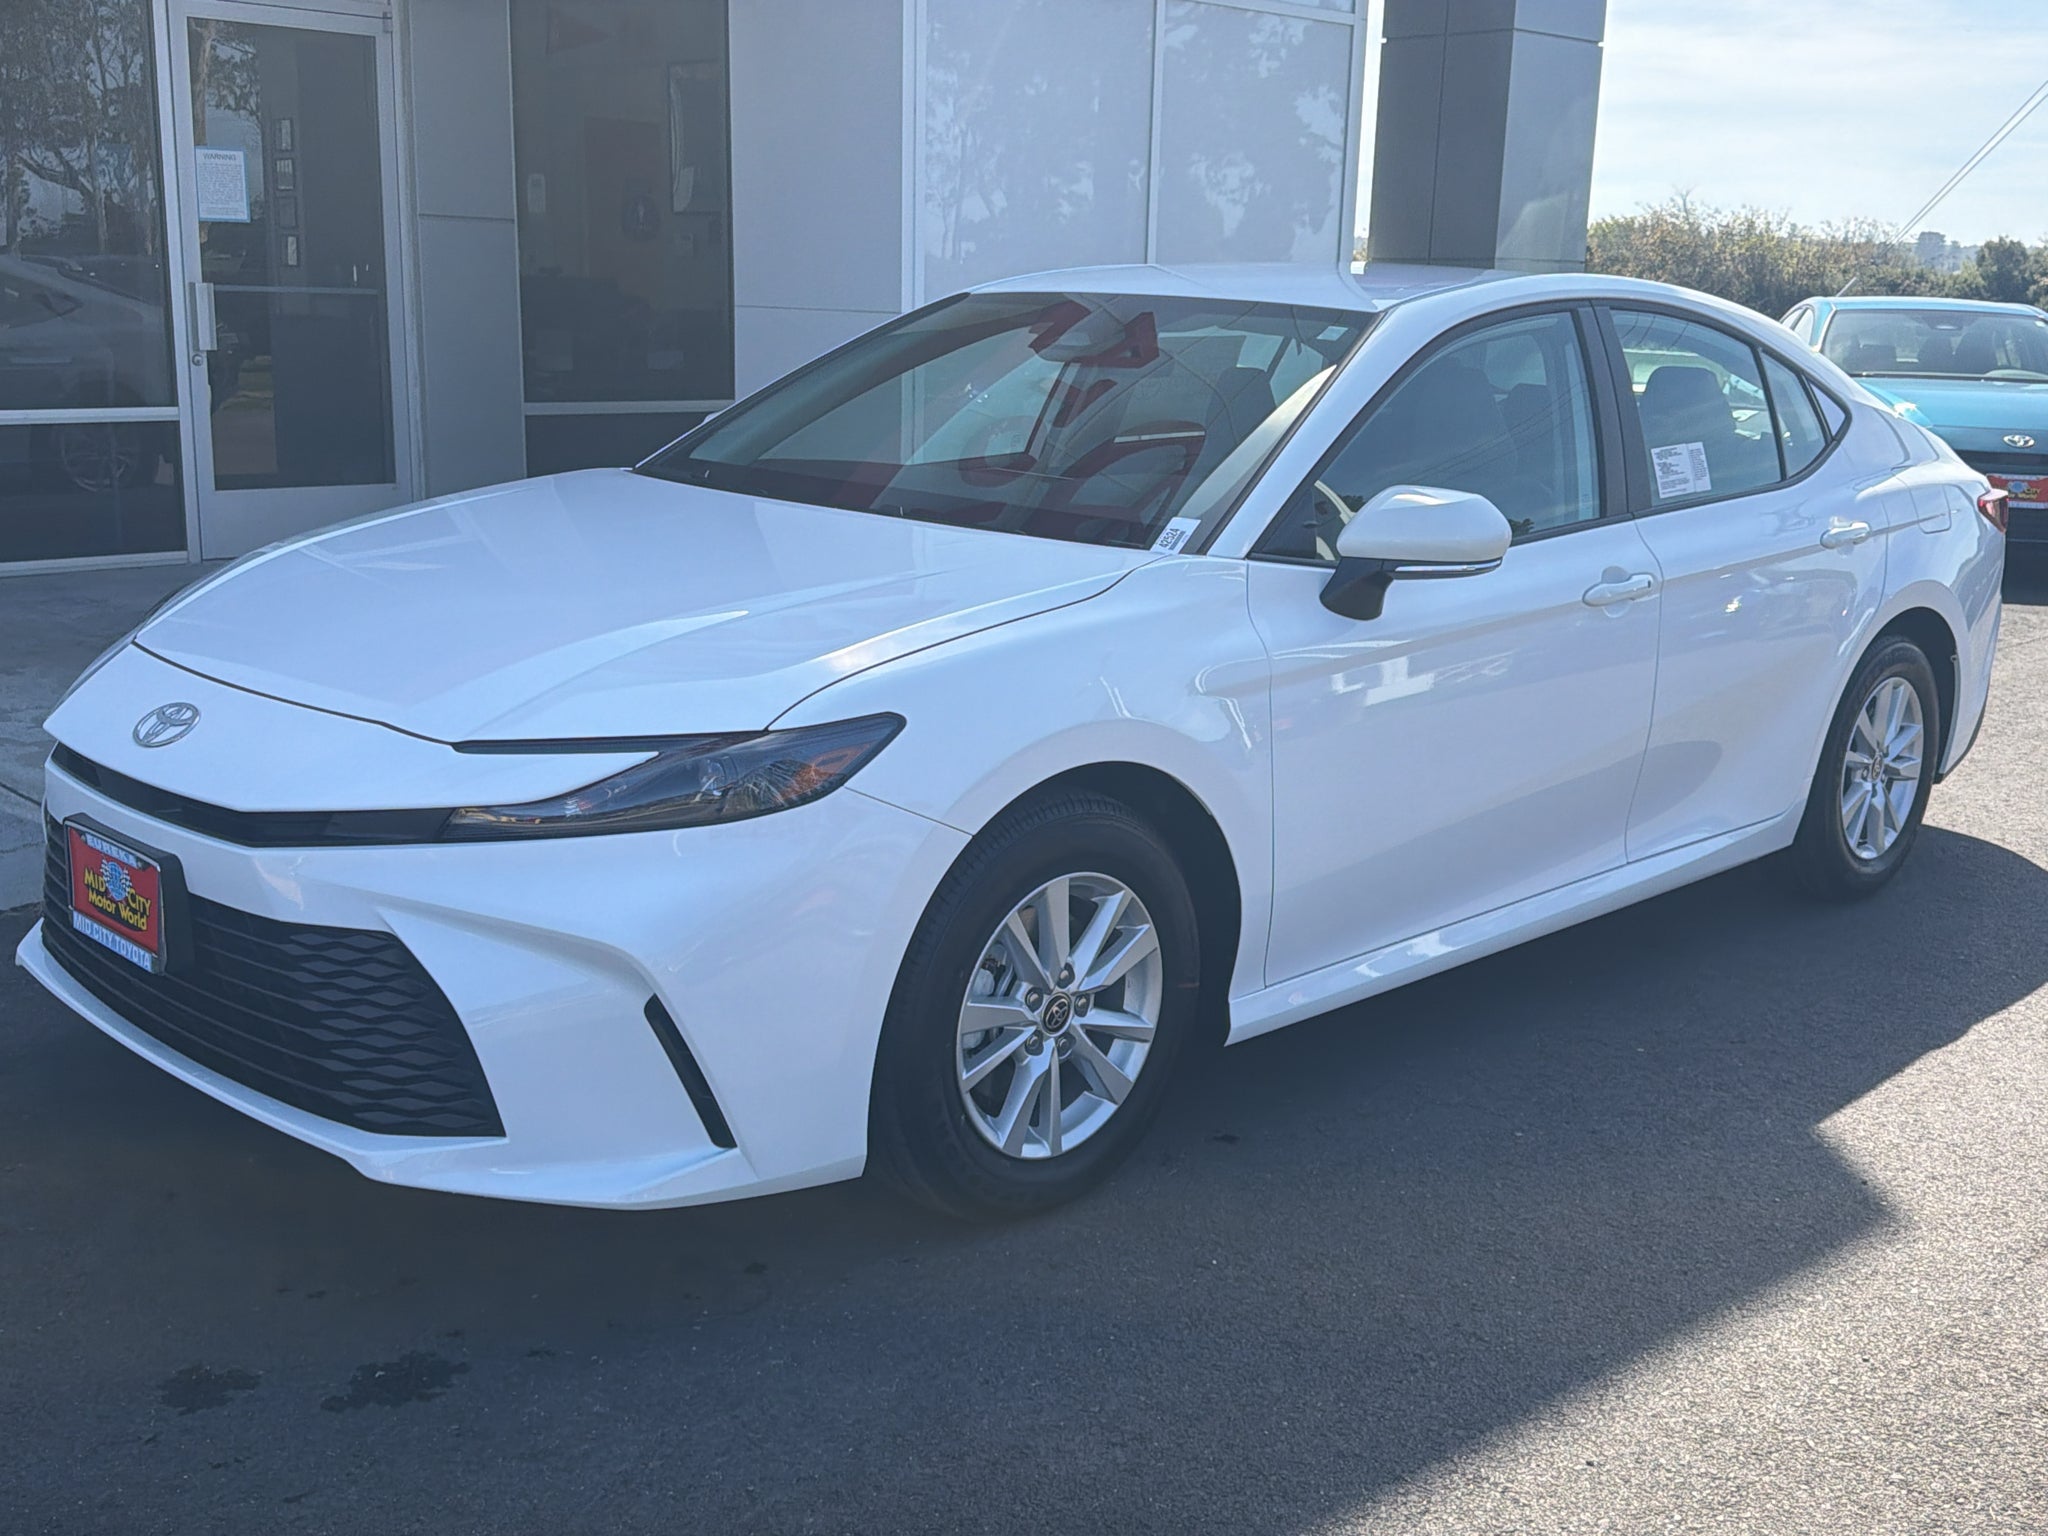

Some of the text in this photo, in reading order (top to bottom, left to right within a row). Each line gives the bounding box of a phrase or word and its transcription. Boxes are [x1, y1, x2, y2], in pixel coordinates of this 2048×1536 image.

[203, 153, 236, 161] WARNING
[84, 867, 151, 916] MID CITY
[89, 890, 147, 931] Motor World
[75, 912, 151, 969] MID CITY TOYOTA
